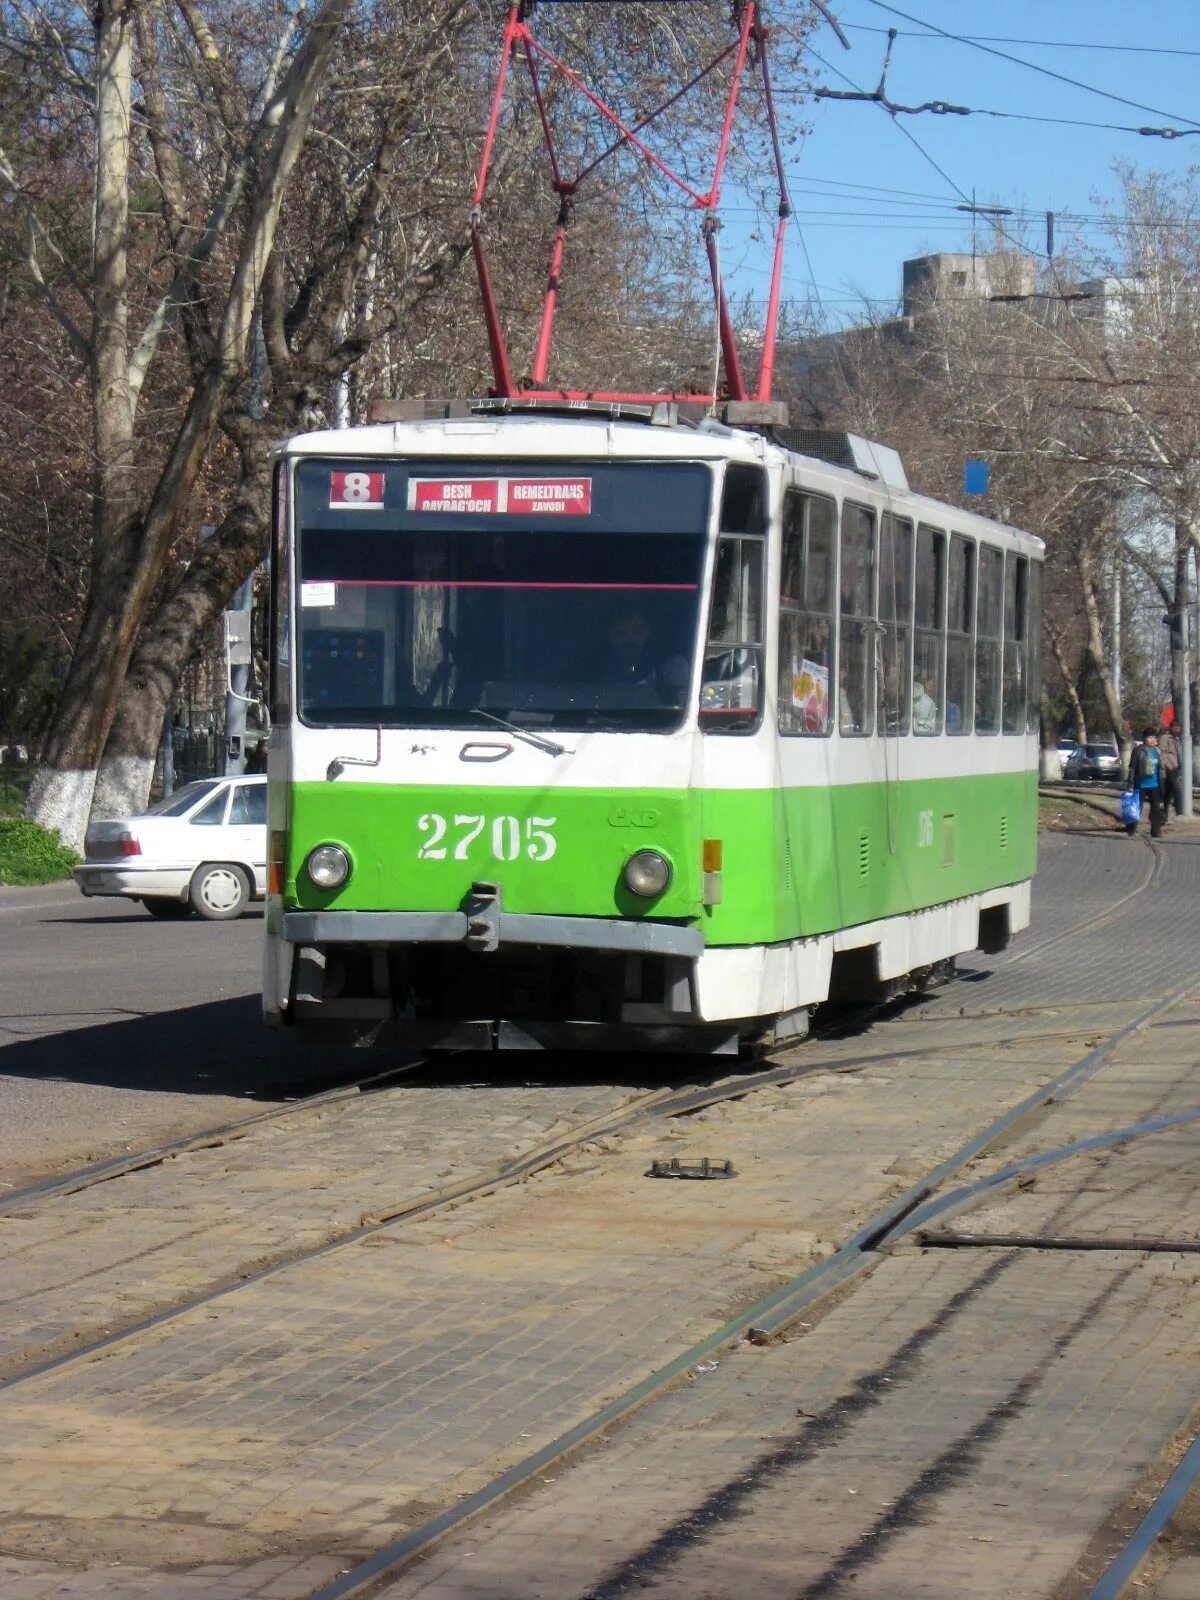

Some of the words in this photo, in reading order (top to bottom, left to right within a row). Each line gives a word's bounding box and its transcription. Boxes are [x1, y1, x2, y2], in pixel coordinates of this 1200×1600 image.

[343, 472, 371, 503] 8
[443, 485, 472, 499] BESH
[513, 485, 584, 499] REMELTRANS
[531, 501, 565, 512] ZAVODI
[417, 813, 557, 862] 2705
